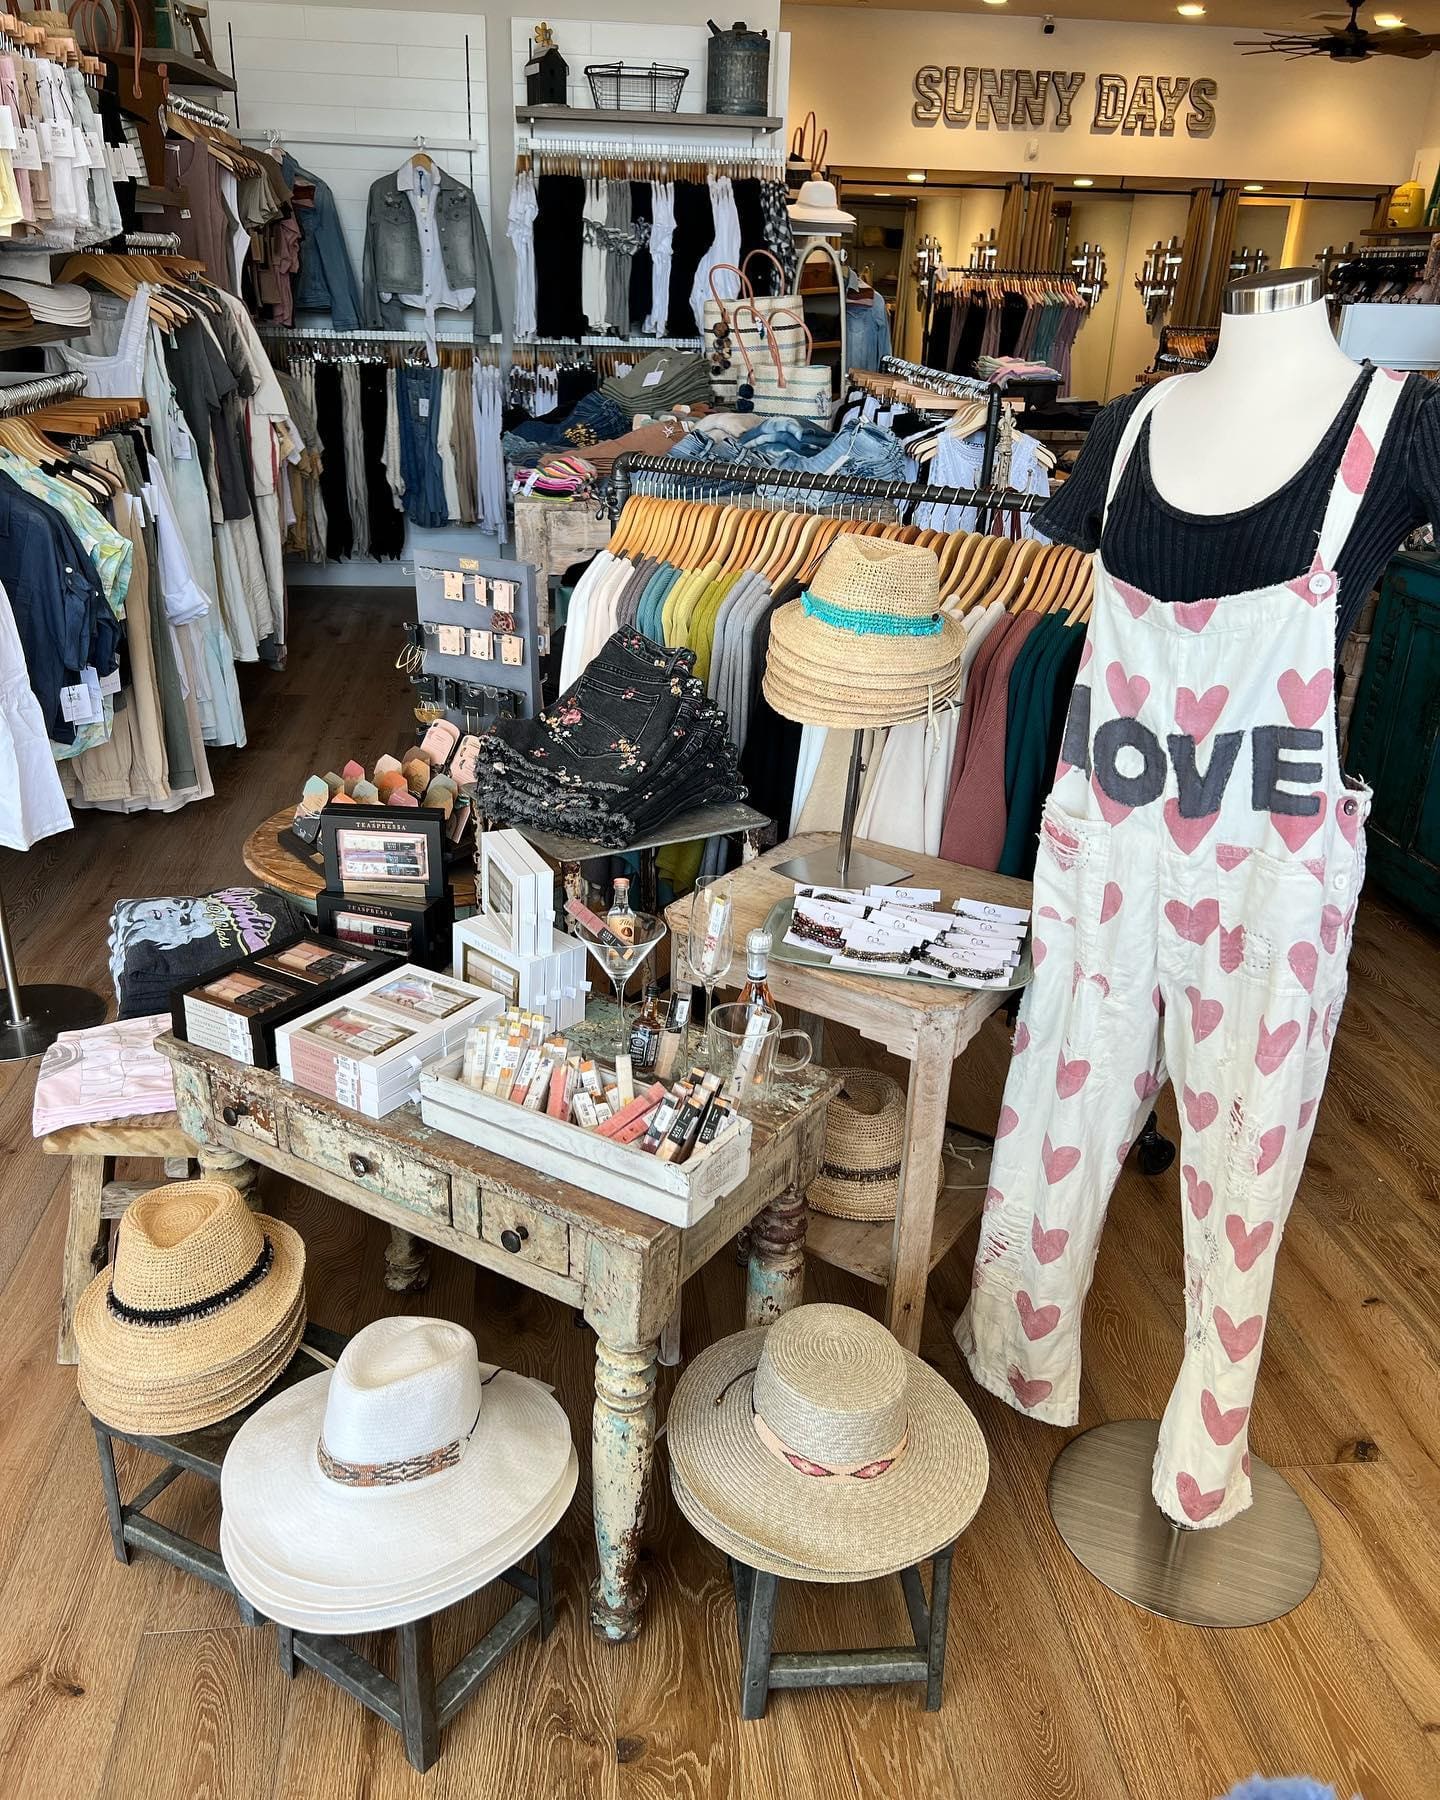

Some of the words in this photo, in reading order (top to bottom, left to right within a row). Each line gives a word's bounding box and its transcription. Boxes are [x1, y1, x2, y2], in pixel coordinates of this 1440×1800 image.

[914, 65, 1086, 127] SUNNY
[1093, 73, 1218, 133] DAYS
[355, 822, 408, 831] TEASPRESSA
[347, 904, 394, 917] TEASPRESSA
